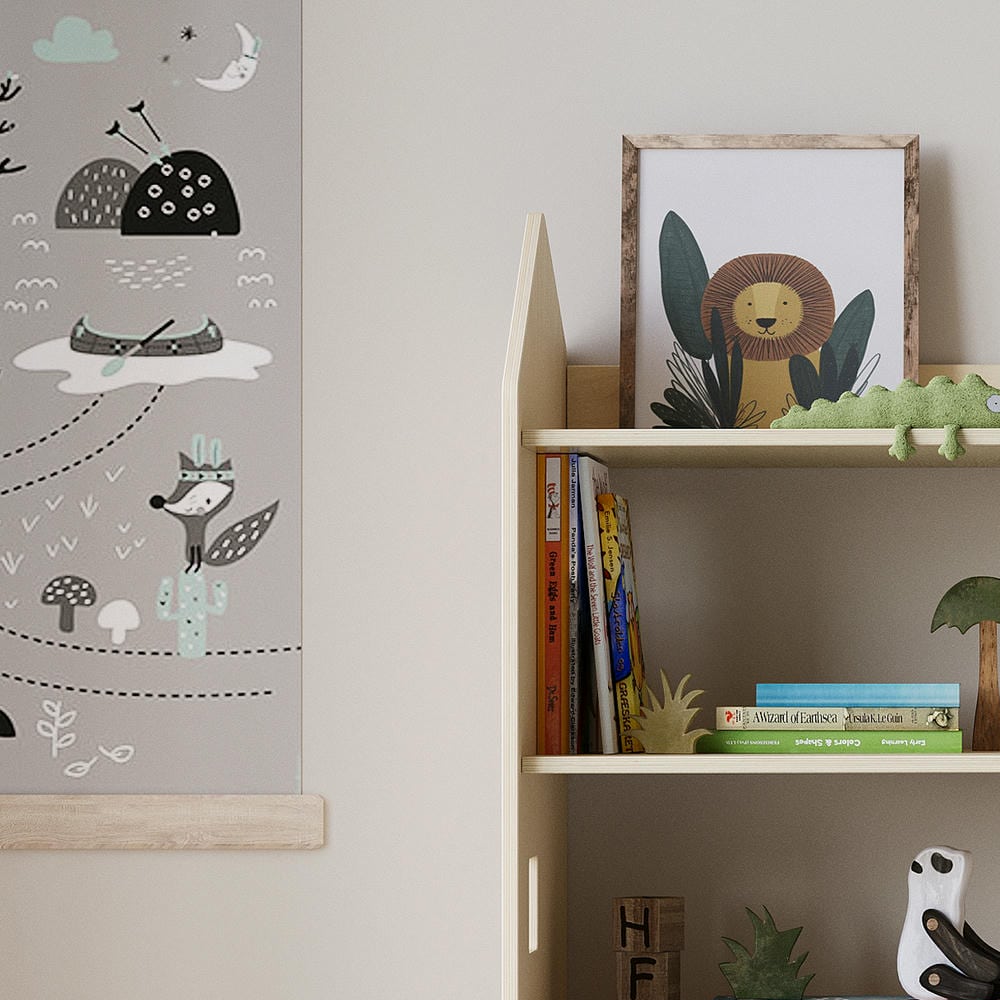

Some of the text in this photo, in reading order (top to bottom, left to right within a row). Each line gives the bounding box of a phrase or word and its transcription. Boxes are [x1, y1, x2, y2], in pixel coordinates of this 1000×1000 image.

[604, 510, 612, 533] Emilie
[588, 556, 596, 569] Wolf
[607, 545, 615, 573] Jensen
[589, 582, 597, 593] the
[547, 551, 558, 643] Green Eggs and Ham
[590, 593, 598, 611] Seven
[592, 612, 600, 627] Little
[593, 628, 601, 645] Goats
[760, 710, 788, 723] Wizard
[790, 710, 799, 723] of
[800, 711, 838, 724] Earthsea
[877, 713, 886, 723] Le
[886, 712, 903, 723] Guin
[794, 738, 861, 747] Colors & Shapes
[881, 738, 926, 747] Early Learning
[619, 905, 650, 949] H
[630, 957, 657, 1000] F
